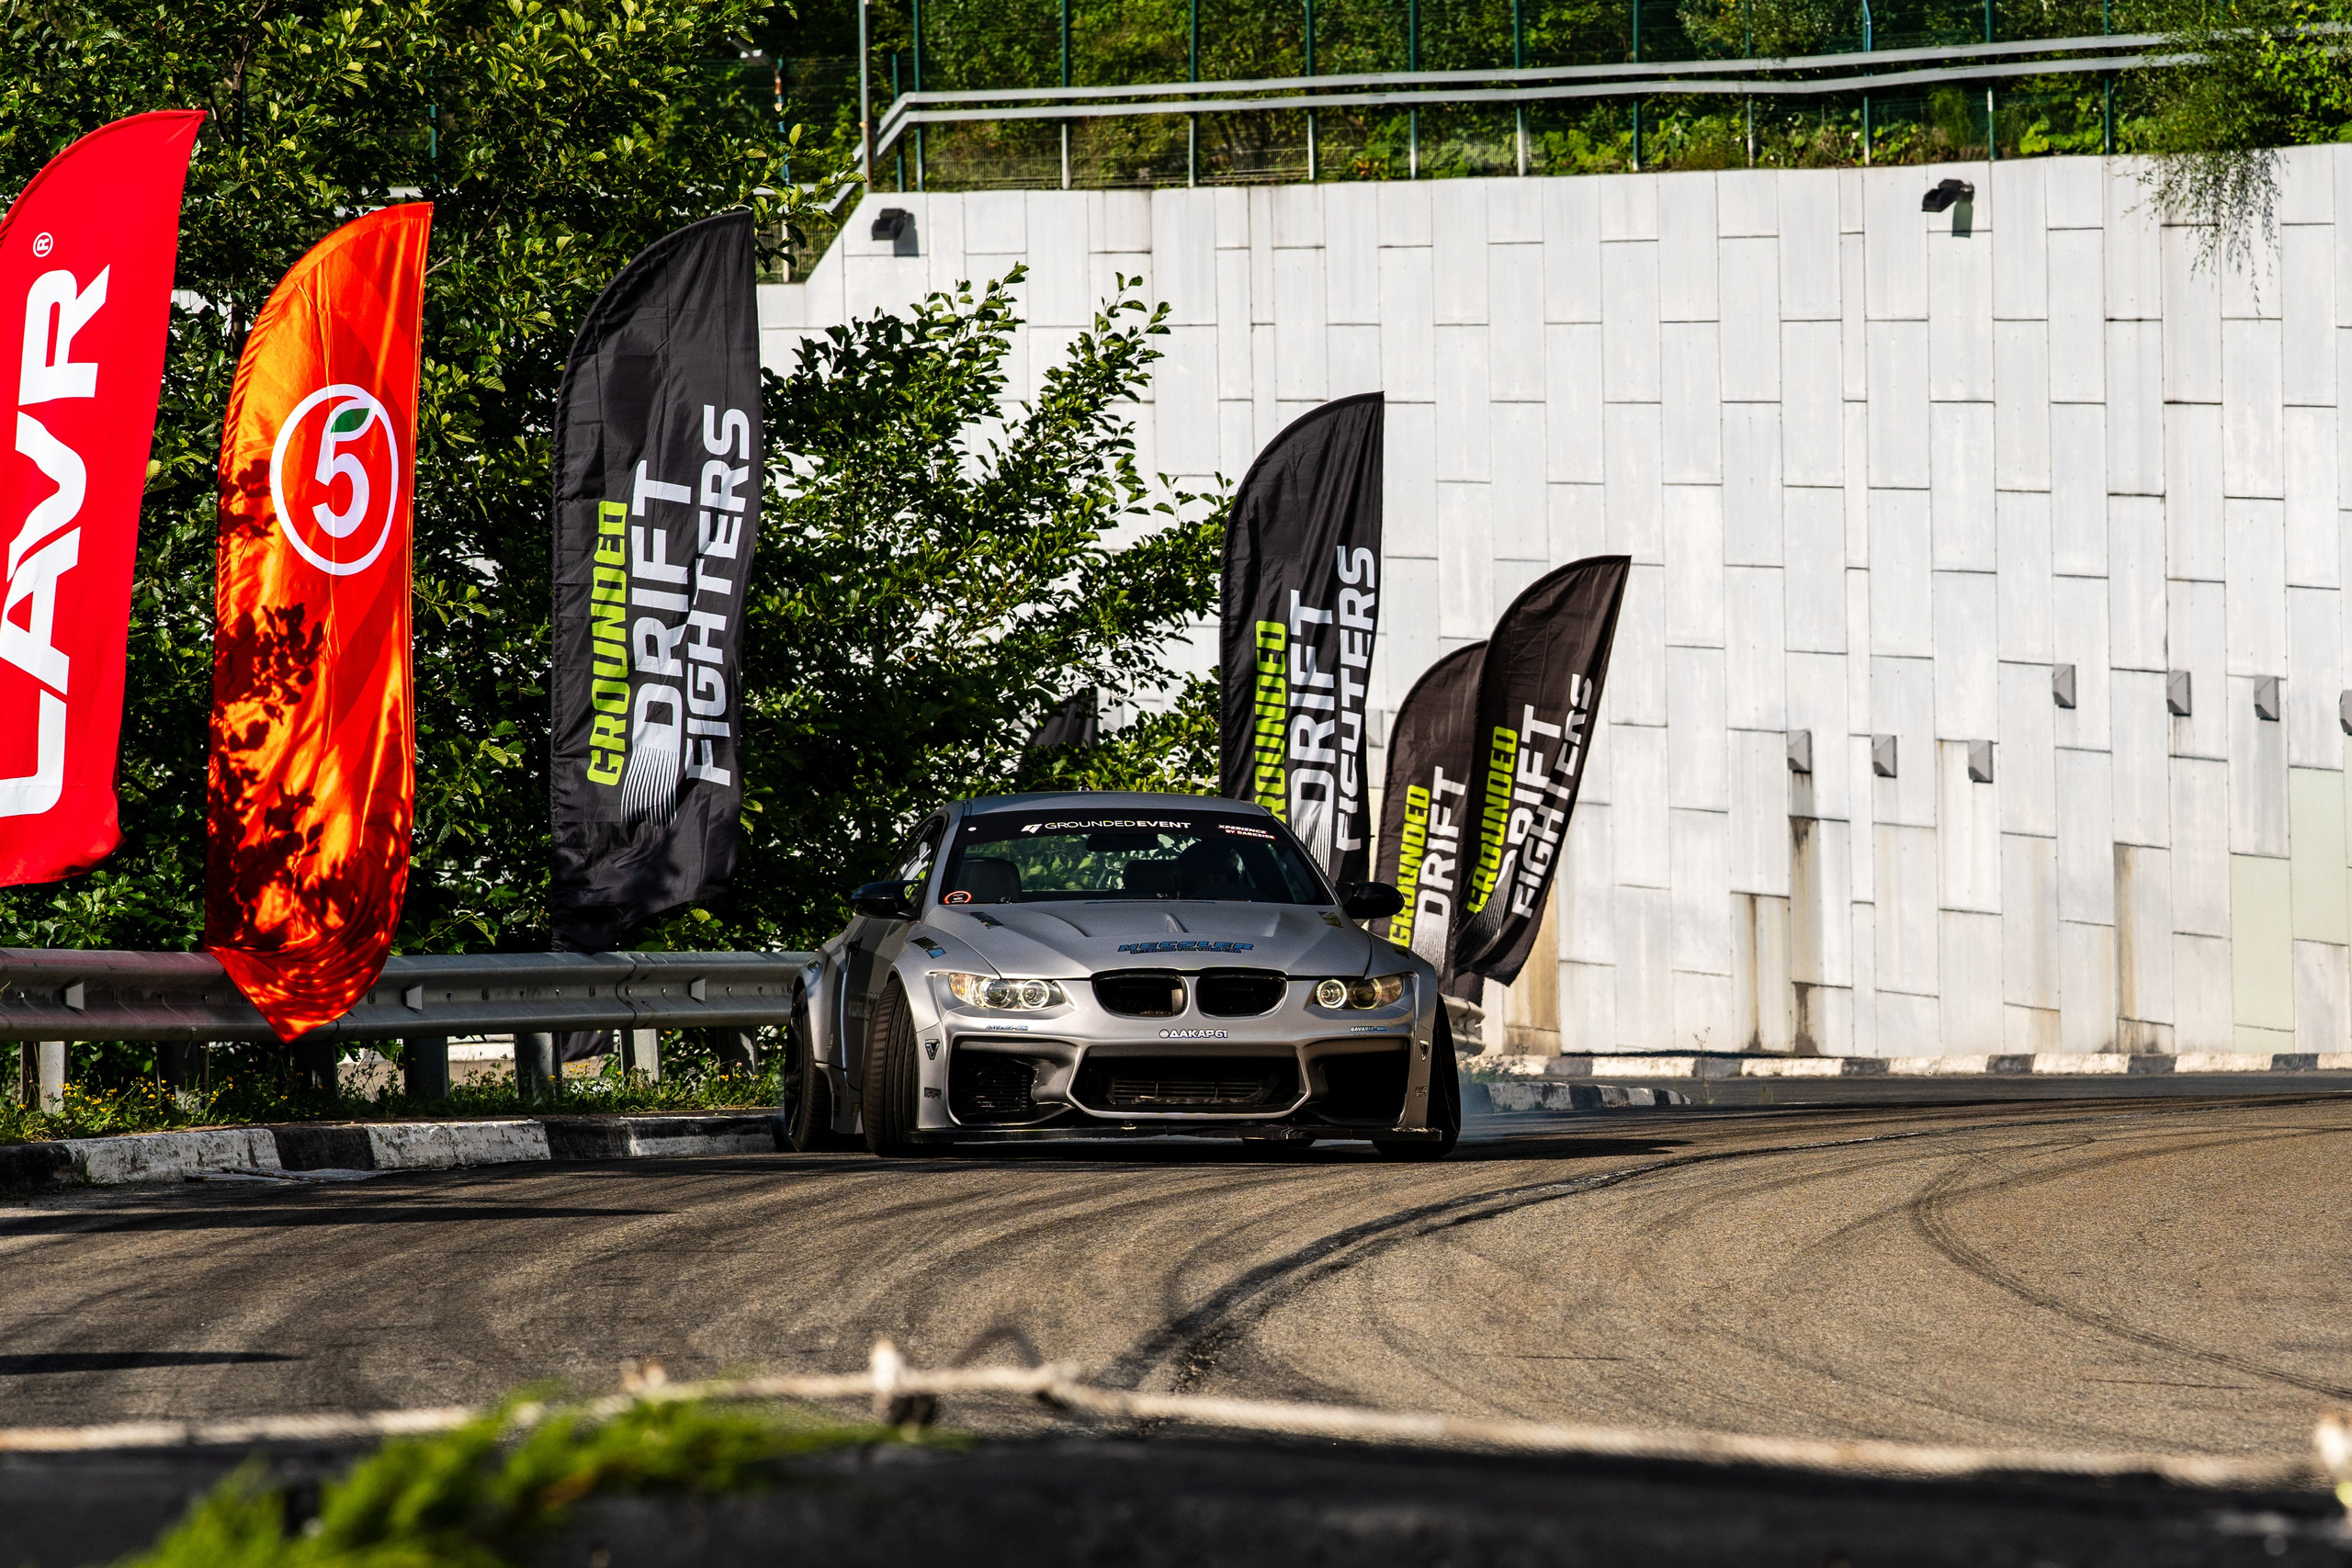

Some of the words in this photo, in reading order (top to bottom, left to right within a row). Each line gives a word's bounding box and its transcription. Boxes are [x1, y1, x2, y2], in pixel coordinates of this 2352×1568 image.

[0, 265, 109, 817] LAVR
[312, 402, 371, 538] 5
[684, 404, 751, 787] FIGHTERS
[587, 501, 630, 785] GROUNDED
[623, 460, 695, 799] DRIFT
[1254, 620, 1286, 821] ROUNDED
[1290, 589, 1337, 854] DRIFT
[1388, 784, 1430, 949] GROUNDED
[1409, 766, 1466, 955] DRIFT
